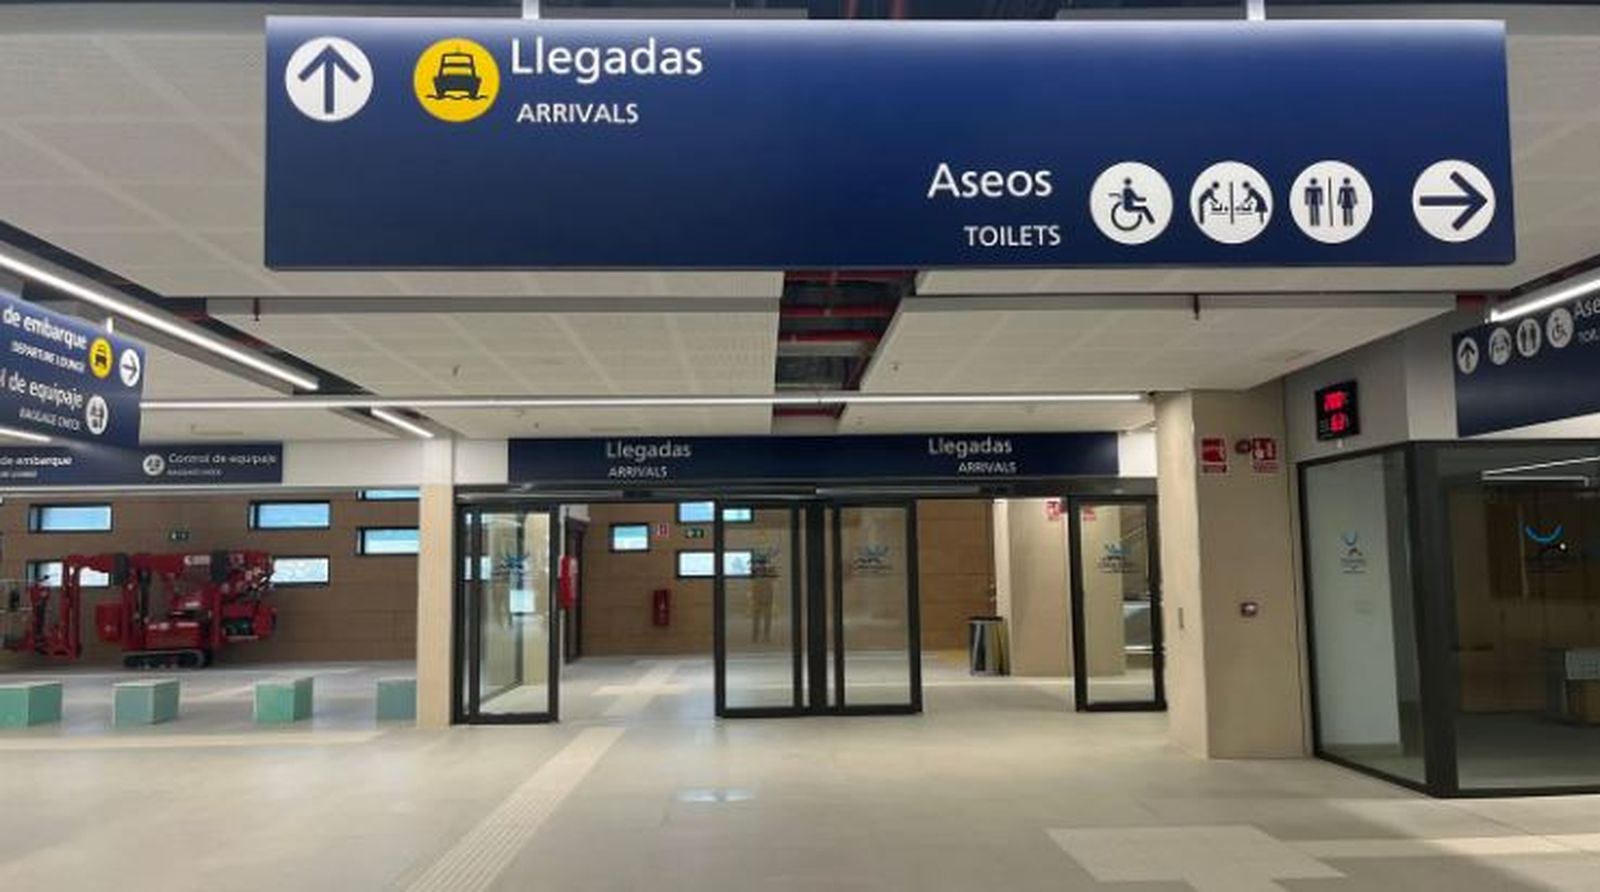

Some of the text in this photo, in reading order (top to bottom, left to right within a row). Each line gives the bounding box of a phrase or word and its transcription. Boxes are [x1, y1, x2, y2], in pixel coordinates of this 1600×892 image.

[511, 36, 704, 84] Llegadas
[516, 103, 639, 124] ARRIVALS
[927, 162, 1053, 198] Aseos
[964, 225, 1061, 247] TOILETS
[3, 305, 87, 350] de embarque
[8, 371, 26, 394] de
[29, 381, 83, 411] equipaje
[607, 440, 692, 463] Llegadas
[928, 436, 1013, 459] Llegadas
[608, 465, 668, 478] ARRIVALS
[958, 461, 1017, 474] ARRIVALS
